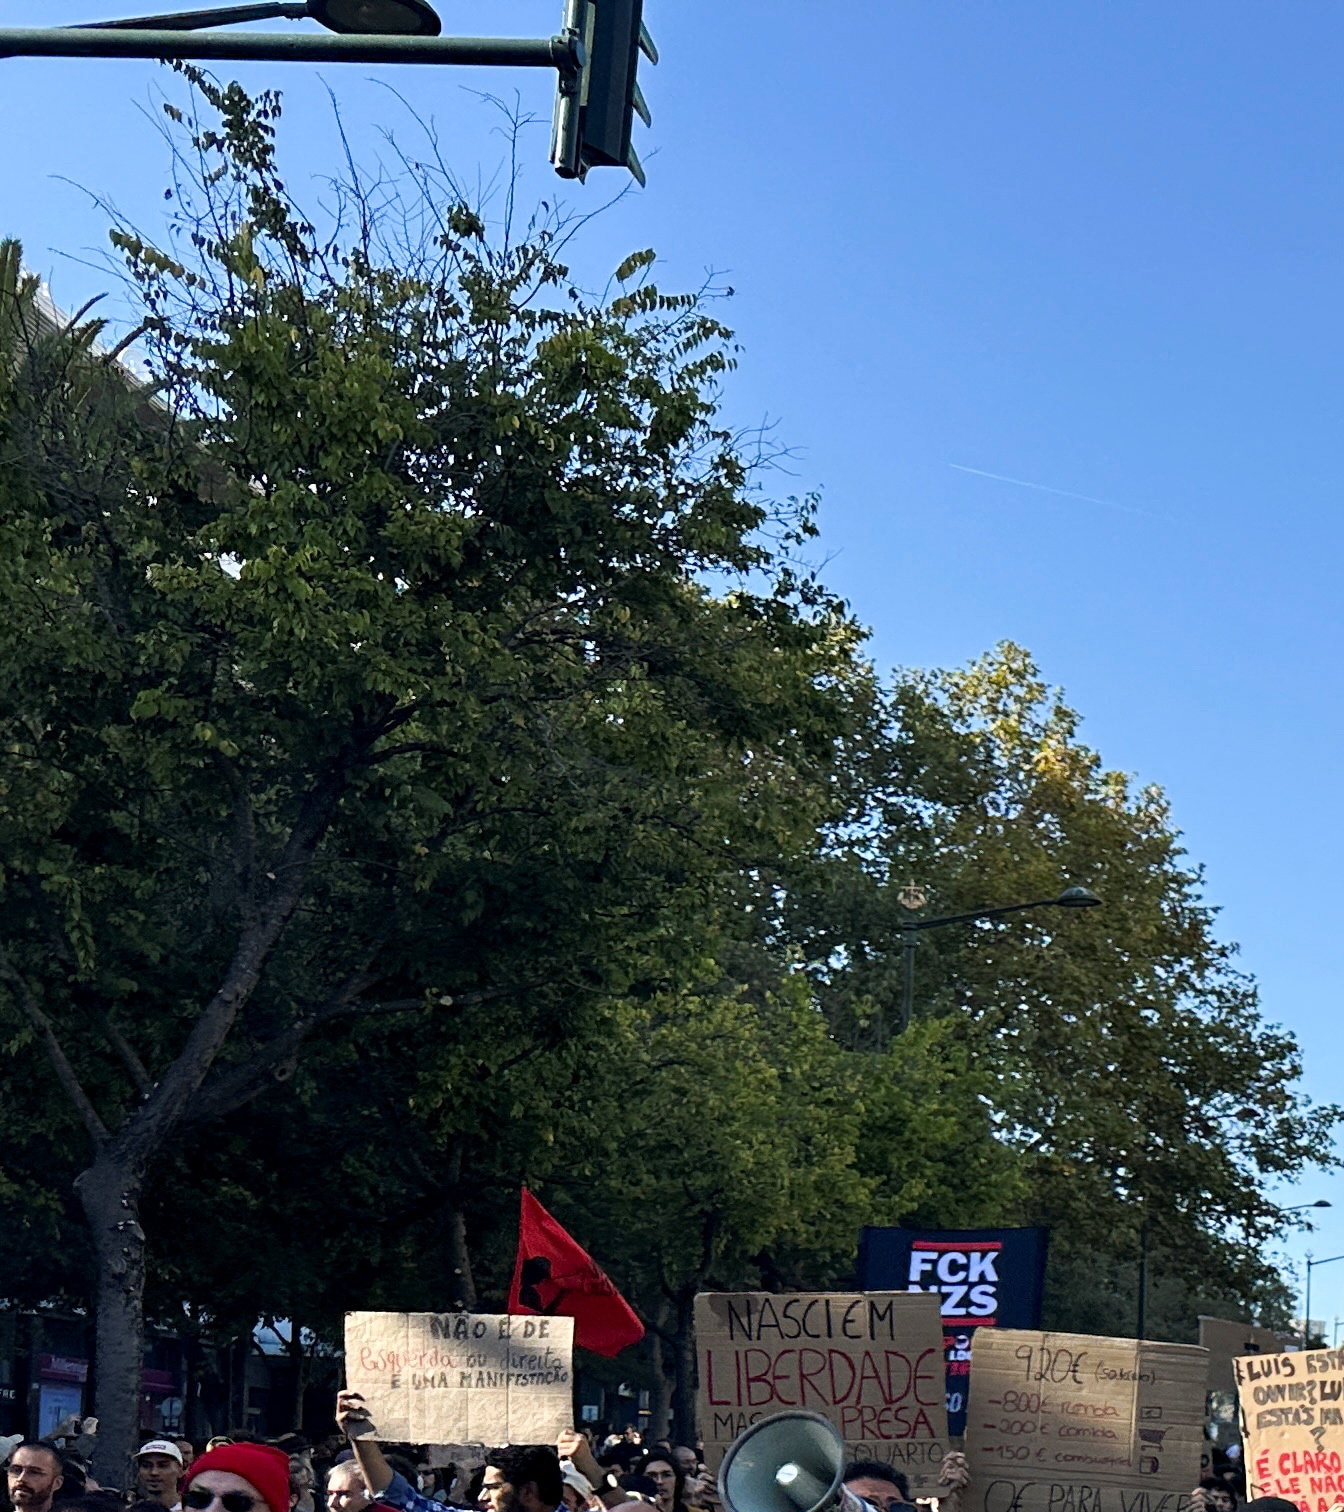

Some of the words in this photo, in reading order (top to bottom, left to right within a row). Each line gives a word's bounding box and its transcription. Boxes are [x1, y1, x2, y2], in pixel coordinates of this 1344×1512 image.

[908, 1250, 1000, 1283] FCK
[908, 1283, 999, 1317] ZS
[429, 1312, 488, 1342] NÃO
[522, 1319, 551, 1340] DE
[727, 1298, 833, 1341] NASCI
[842, 1299, 896, 1341] EM
[706, 1347, 940, 1407] LIBERDADE
[1014, 1344, 1089, 1386] 920€
[1246, 1353, 1296, 1382] LUÍS
[840, 1405, 938, 1440] PRESA
[1058, 1423, 1119, 1441] comida
[853, 1442, 945, 1465] QUARTO
[1309, 1426, 1326, 1452] ?
[1256, 1448, 1272, 1479] É
[1278, 1450, 1341, 1477] CLARO
[1258, 1476, 1302, 1497] ELE
